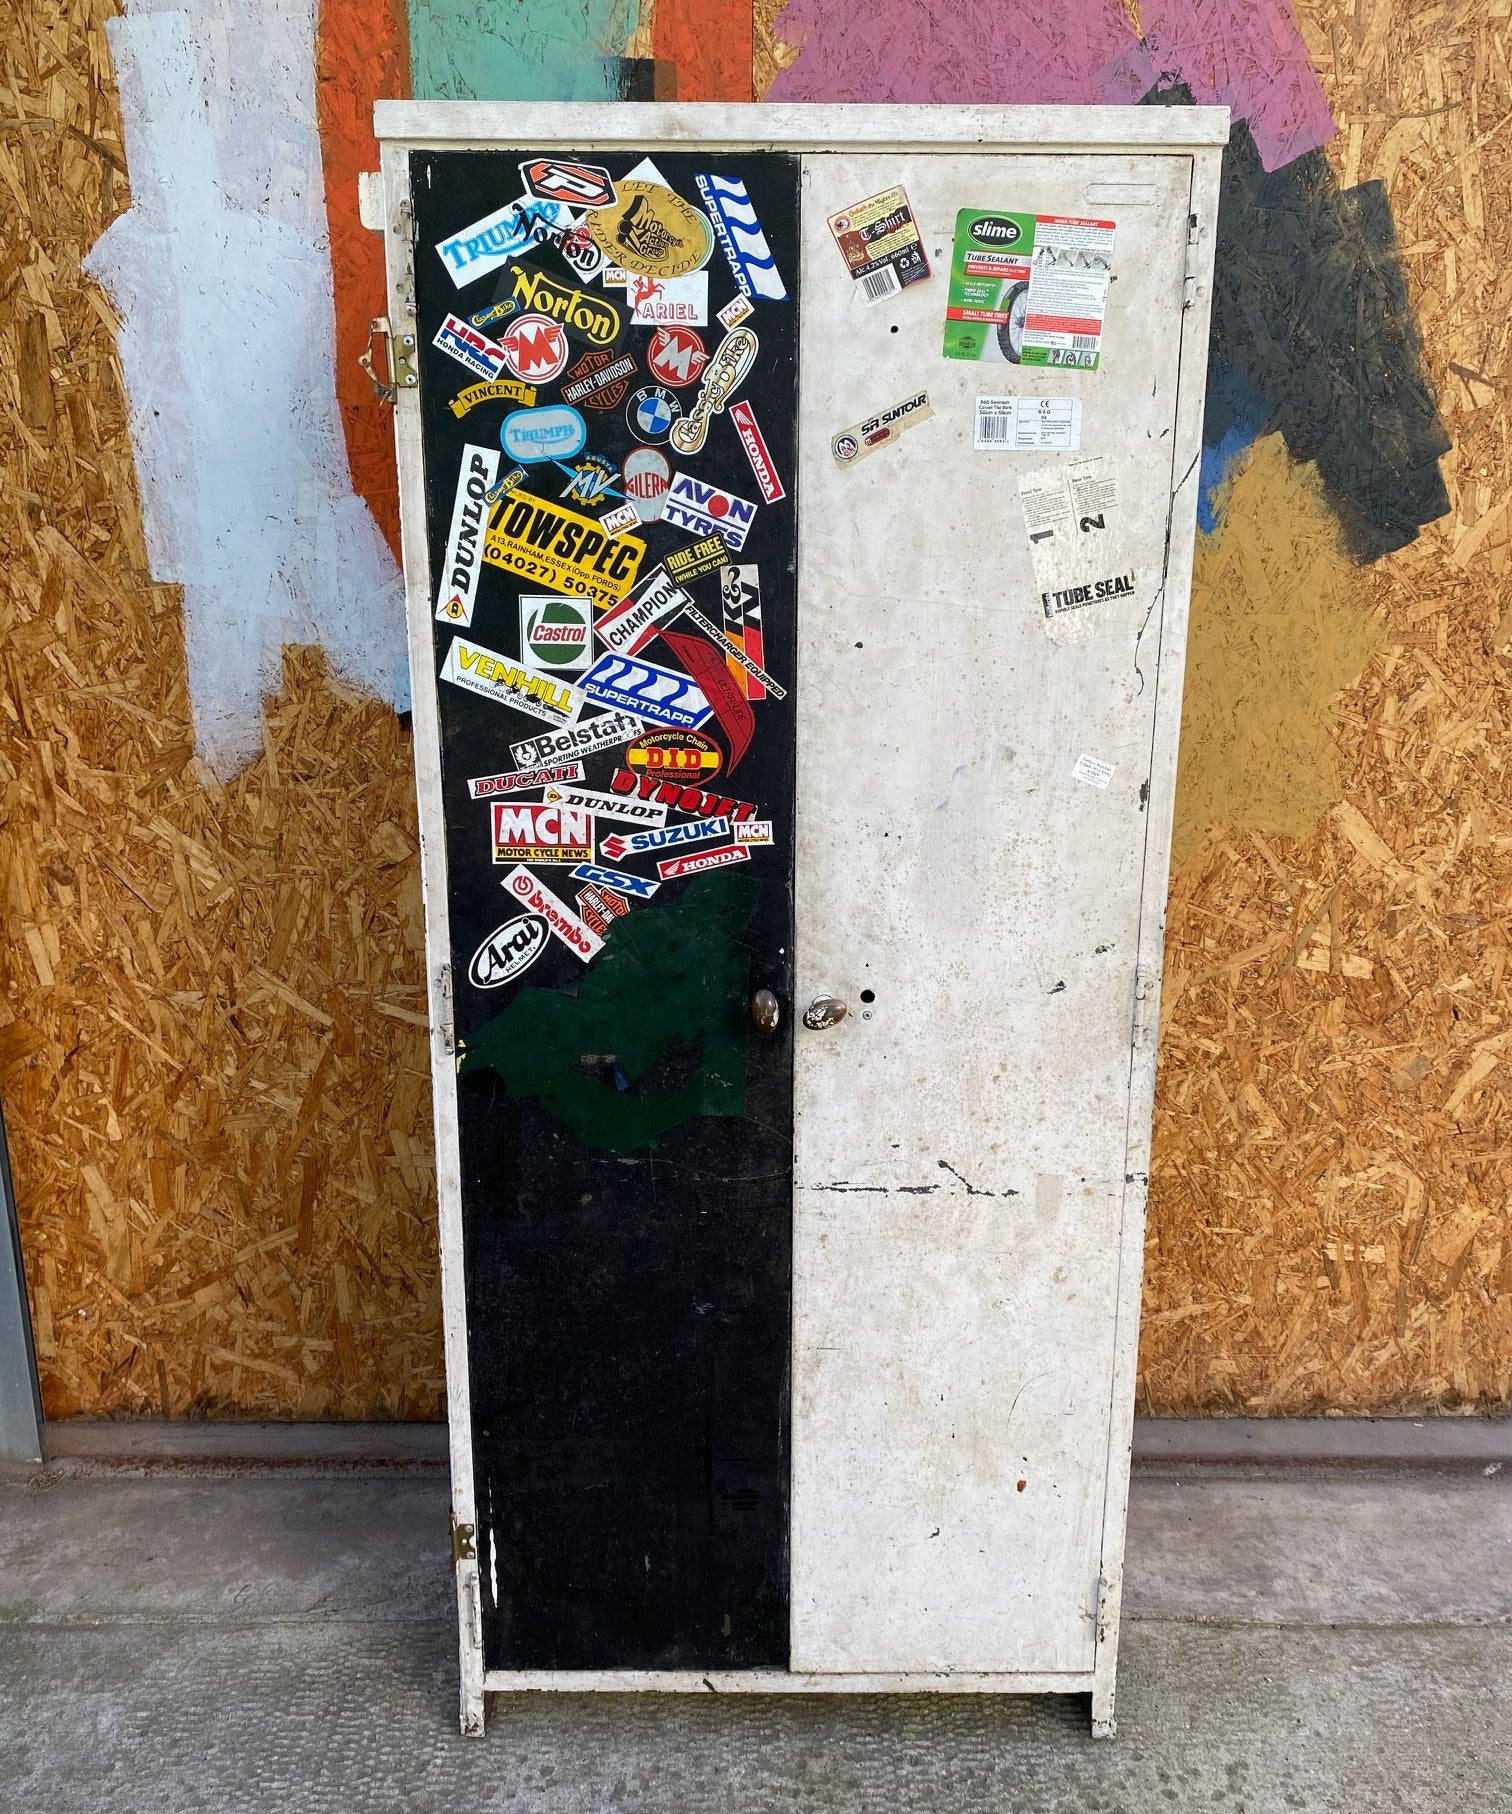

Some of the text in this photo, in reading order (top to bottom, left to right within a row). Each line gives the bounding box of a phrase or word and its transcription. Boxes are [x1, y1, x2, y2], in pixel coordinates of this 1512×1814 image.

[621, 182, 698, 225] LET THE
[586, 209, 627, 266] RIDER
[630, 250, 703, 277] DECIDE
[695, 174, 752, 298] SUPERTRAPP
[973, 220, 1018, 239] slime
[967, 253, 1019, 265] TUBE SEALANT
[605, 270, 627, 281] MCN
[509, 265, 621, 345] Norton
[642, 302, 699, 320] ARIEL
[721, 299, 748, 326] MCN
[436, 337, 496, 380] HONDA RACING
[463, 385, 523, 406] VINCENT
[564, 359, 634, 402] HARLEY-DAVIDSON
[881, 393, 927, 426] SUNTOUR
[509, 423, 577, 444] TRIUMPH
[742, 429, 775, 499] HONDA
[559, 470, 622, 498] MV
[451, 453, 490, 595] DUNLOP
[604, 507, 636, 531] MCN
[1079, 513, 1106, 533] 2
[488, 498, 639, 581] TOWSPEC
[666, 536, 724, 570] RIDE FREE
[484, 543, 619, 607] (04027) 50375
[592, 574, 622, 592] FORDS)
[675, 555, 729, 583] (WHILE YOU CAN)
[1052, 584, 1095, 609] TUBE
[1094, 574, 1134, 599] SEAL
[609, 582, 679, 646] CHAMPION
[532, 624, 587, 642] Castrol
[685, 605, 787, 699] FILTERCHARGER EQUIPPED
[458, 645, 574, 714] VENHILL
[456, 675, 548, 718] PROFESSIONAL PRODUCTS
[585, 682, 695, 726] SUPERTRAPP
[543, 748, 580, 767] SPORTING
[639, 732, 709, 751] Motorcycle Chain
[475, 764, 578, 796] DUCATI
[646, 769, 700, 779] Professional
[565, 794, 664, 819] DUNLOP
[610, 769, 757, 823] DYNOJET
[498, 807, 588, 845] MCN
[630, 817, 728, 851] SUZUKI
[738, 824, 769, 838] MCN
[497, 847, 588, 858] MOTOR CYCLE NEWS
[682, 849, 746, 873] HONDA
[574, 864, 657, 896] GSX
[602, 894, 625, 915] MOTO
[528, 889, 592, 953] brembo
[484, 916, 539, 985] Arai
